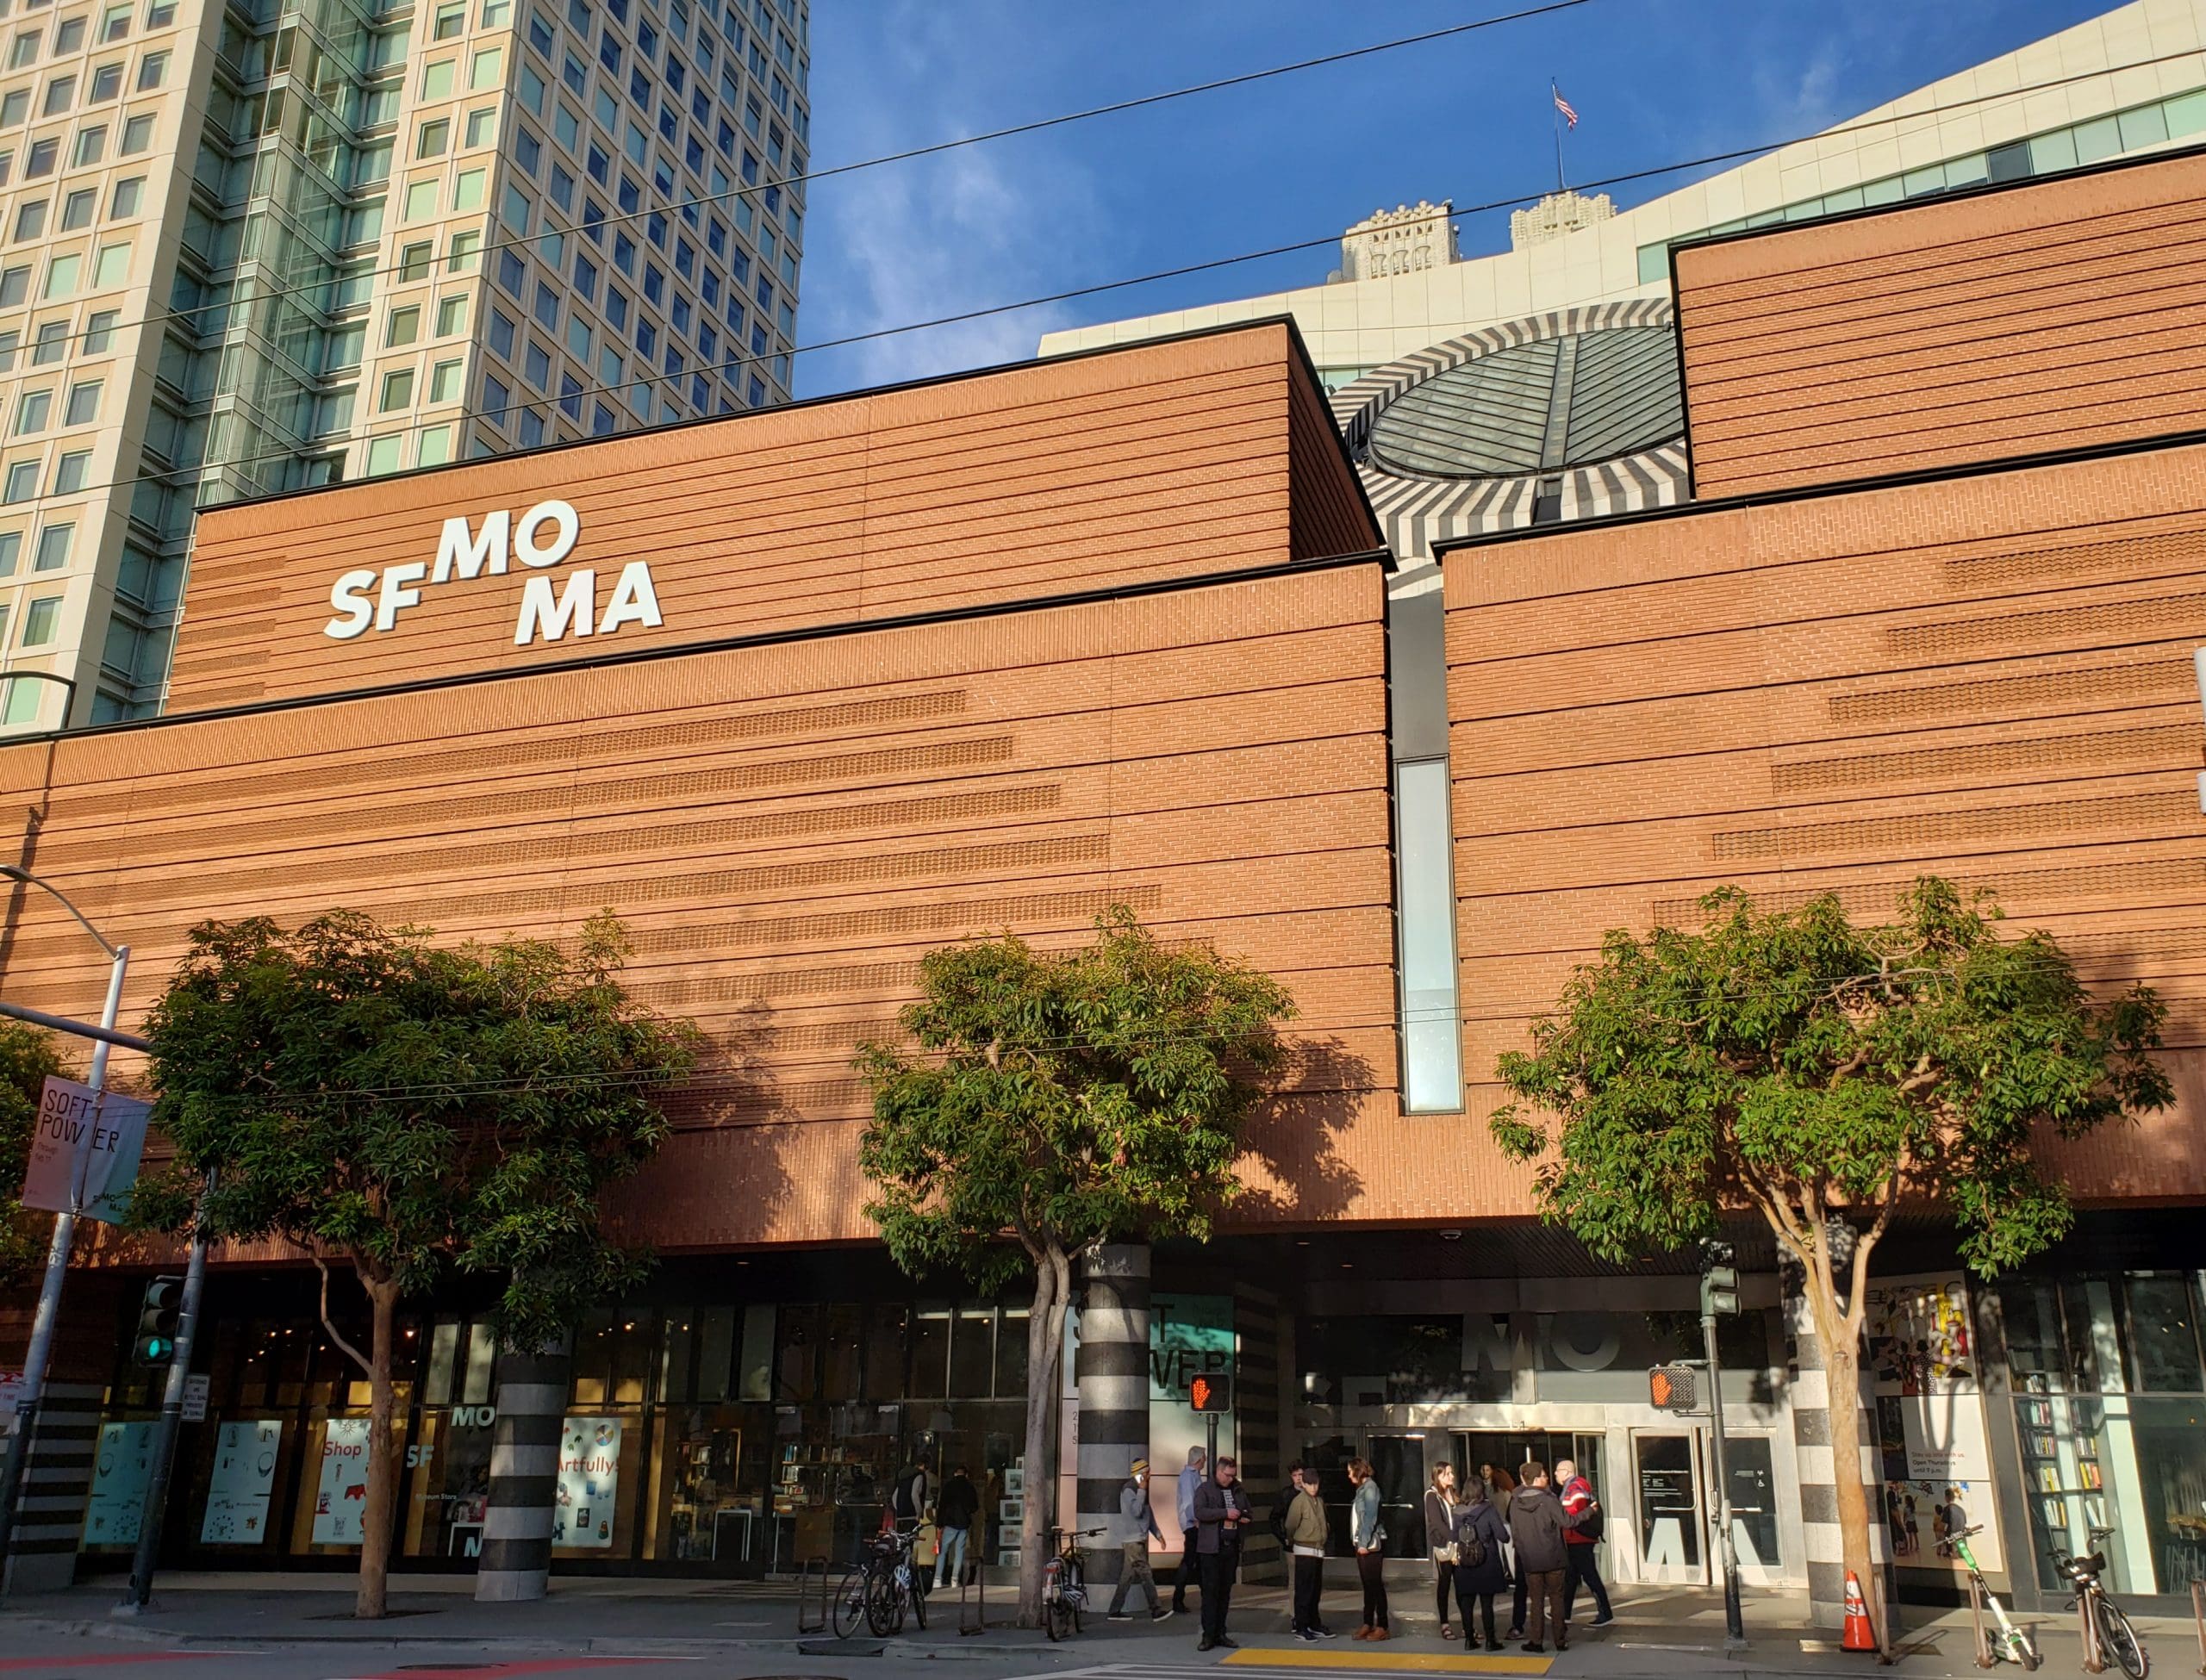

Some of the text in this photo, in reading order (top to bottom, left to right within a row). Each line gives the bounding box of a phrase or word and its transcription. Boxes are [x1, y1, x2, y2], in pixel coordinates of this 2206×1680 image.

[45, 1089, 92, 1119] SOFT
[40, 1114, 119, 1153] POWER
[451, 1407, 495, 1427] MO
[323, 1441, 362, 1459] Shop
[406, 1445, 434, 1468] SF
